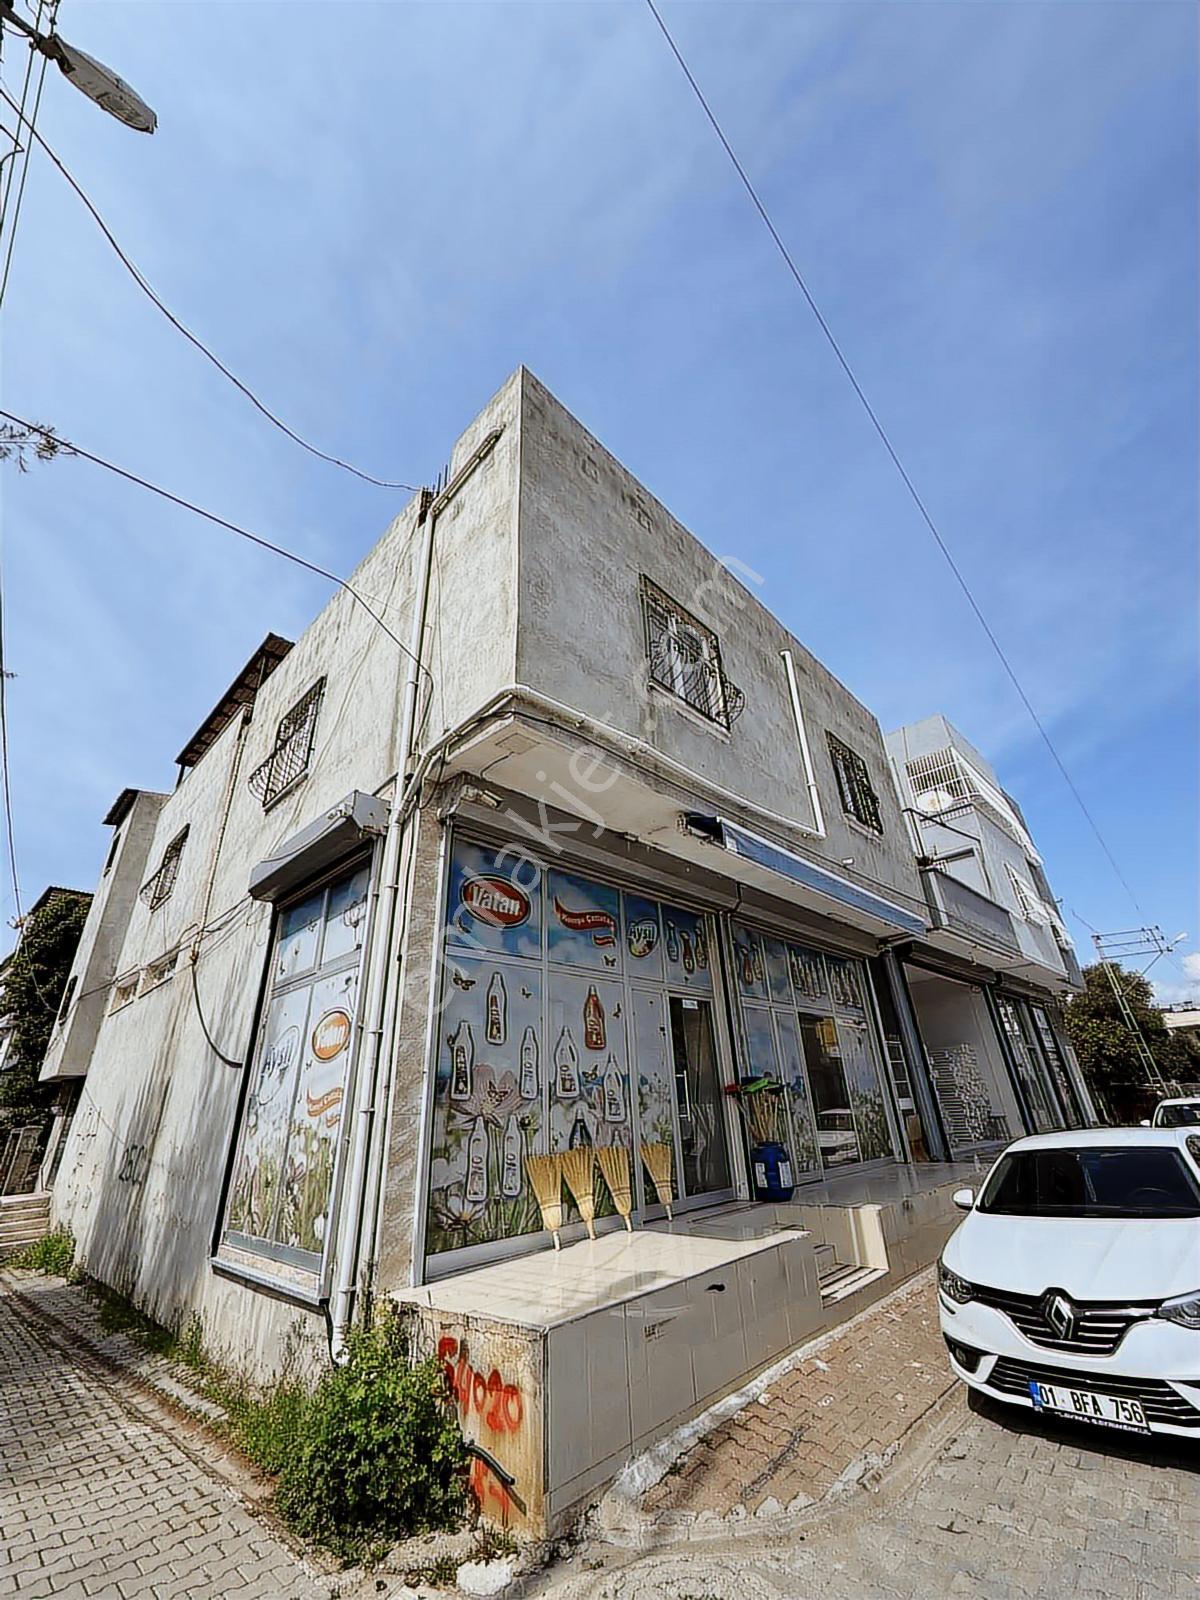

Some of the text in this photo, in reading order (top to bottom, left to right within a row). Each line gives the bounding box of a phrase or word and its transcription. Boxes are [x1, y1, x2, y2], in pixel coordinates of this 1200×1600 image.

[472, 885, 521, 916] Vatan
[1039, 1385, 1058, 1407] 01
[1070, 1391, 1103, 1416] BFA
[1109, 1398, 1144, 1424] 756
